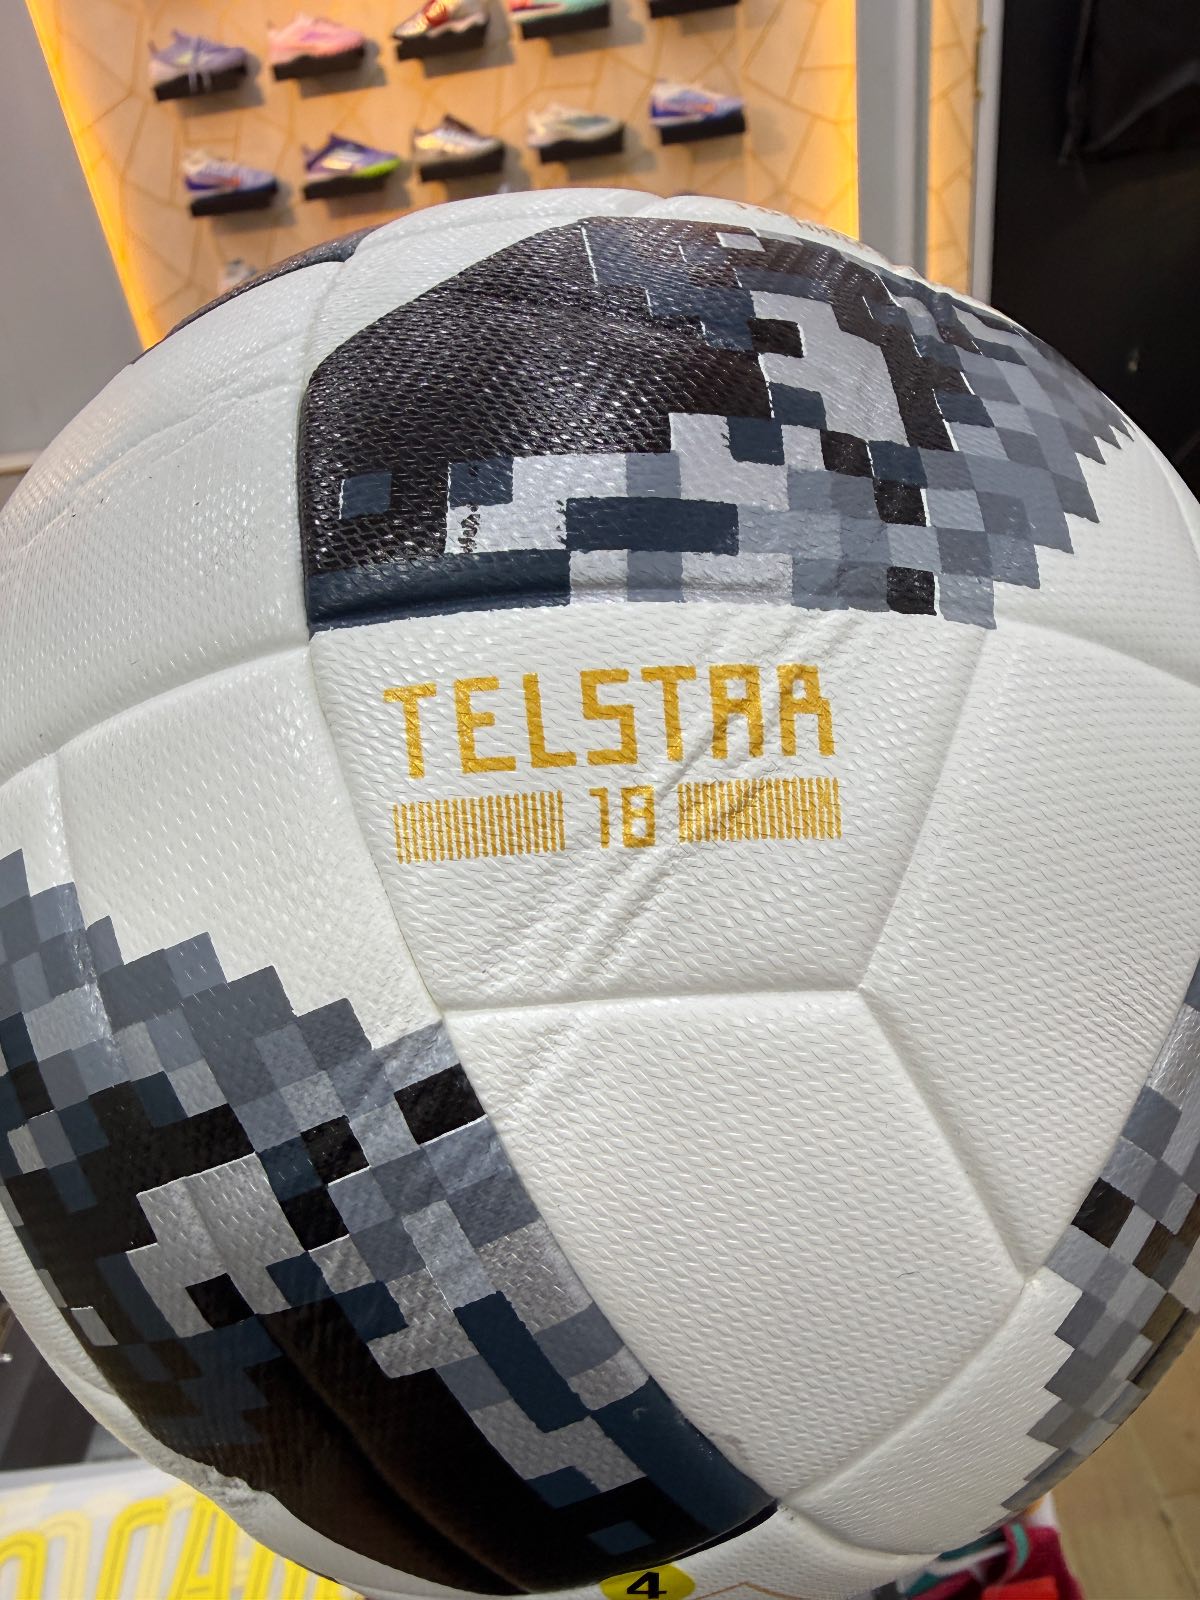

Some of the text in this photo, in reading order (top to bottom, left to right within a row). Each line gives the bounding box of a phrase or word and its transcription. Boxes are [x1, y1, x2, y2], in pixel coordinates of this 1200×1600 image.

[384, 664, 835, 778] TELSTAR
[589, 785, 656, 849] 18
[626, 1571, 668, 1600] 4
